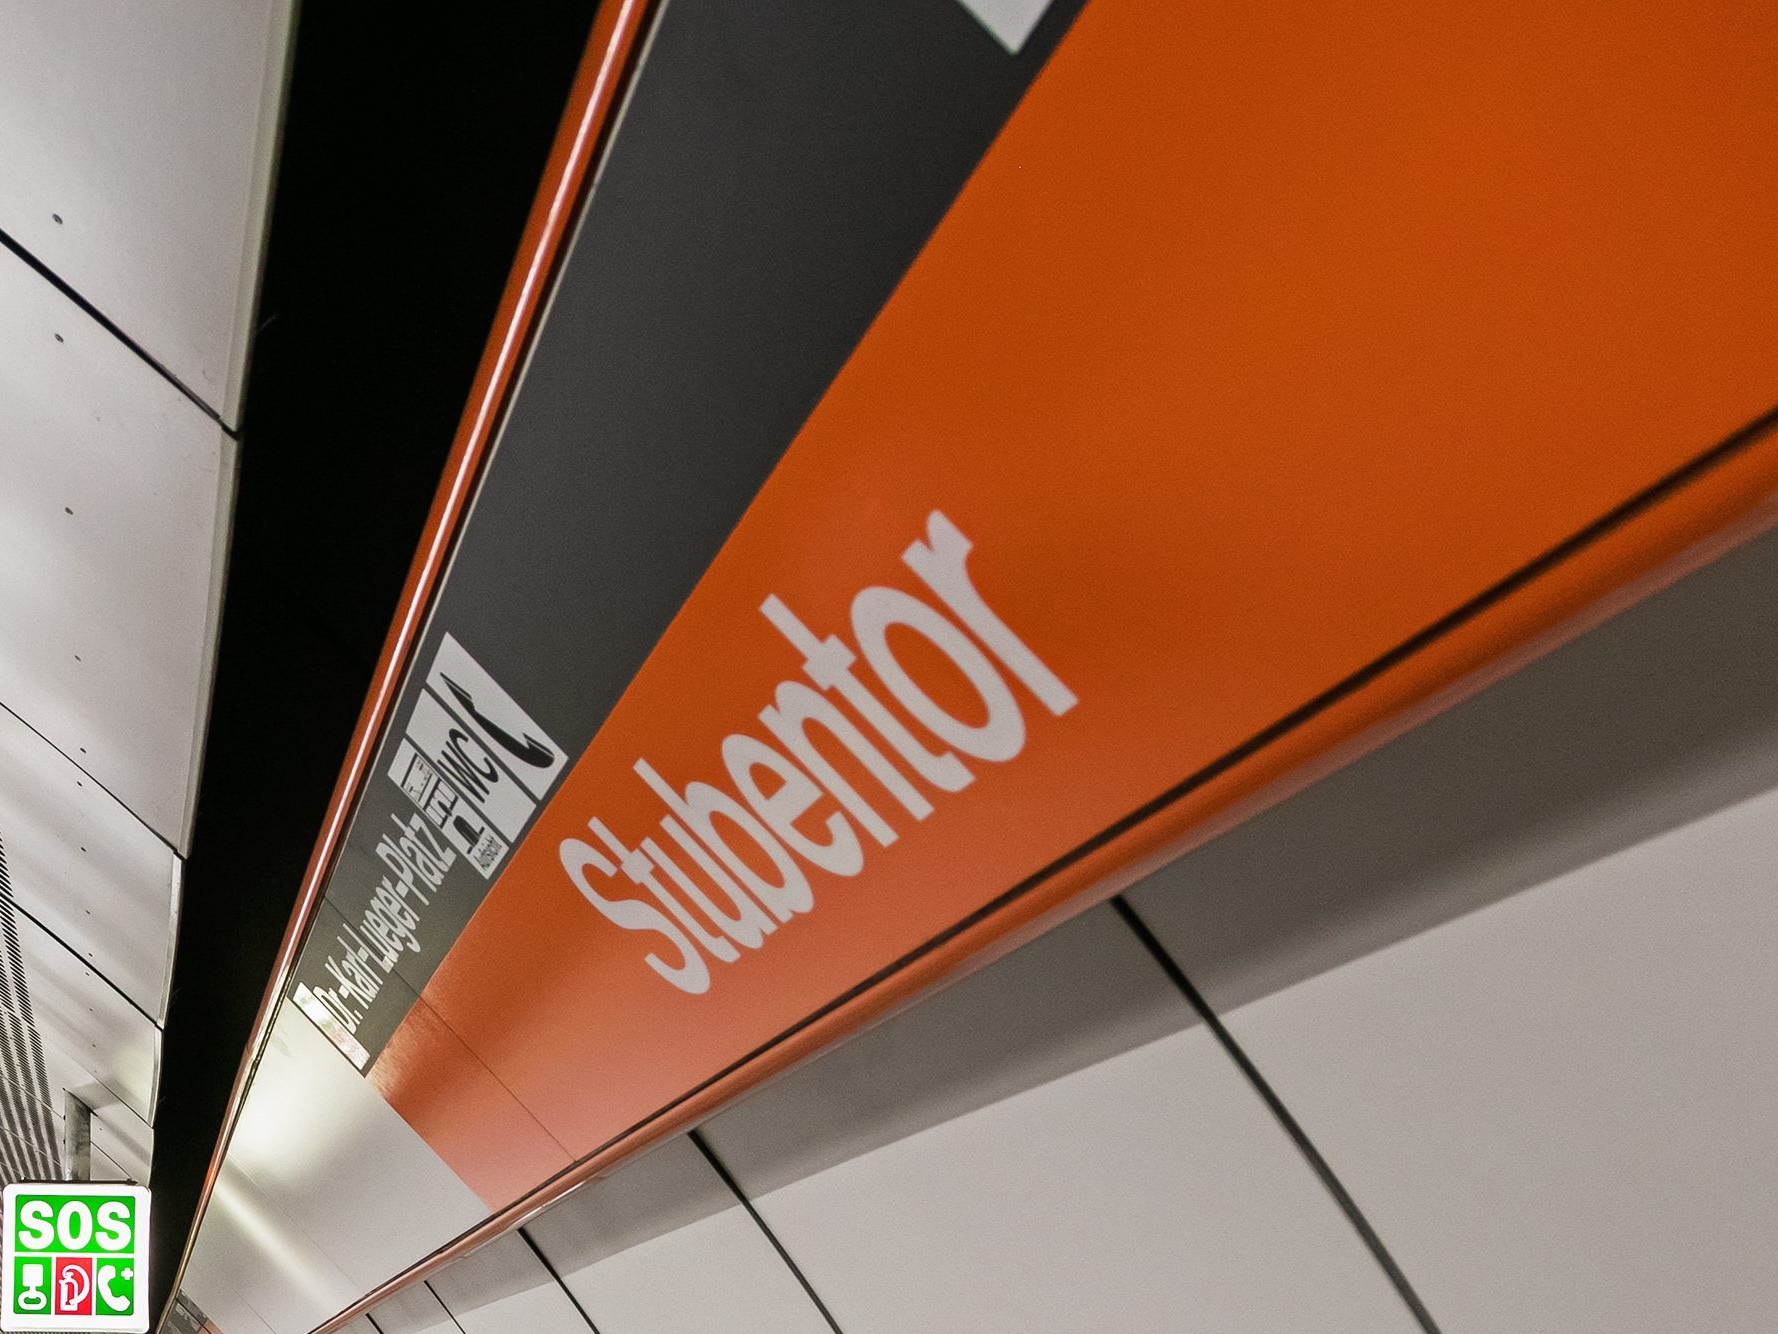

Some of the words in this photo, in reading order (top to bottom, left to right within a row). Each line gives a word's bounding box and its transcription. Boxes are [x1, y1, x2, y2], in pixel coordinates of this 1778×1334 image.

[436, 728, 499, 804] WC
[559, 508, 1078, 995] Stubentor
[312, 812, 457, 1035] Dr.-Karl-Lueger-Platz
[18, 1200, 132, 1251] SOS
